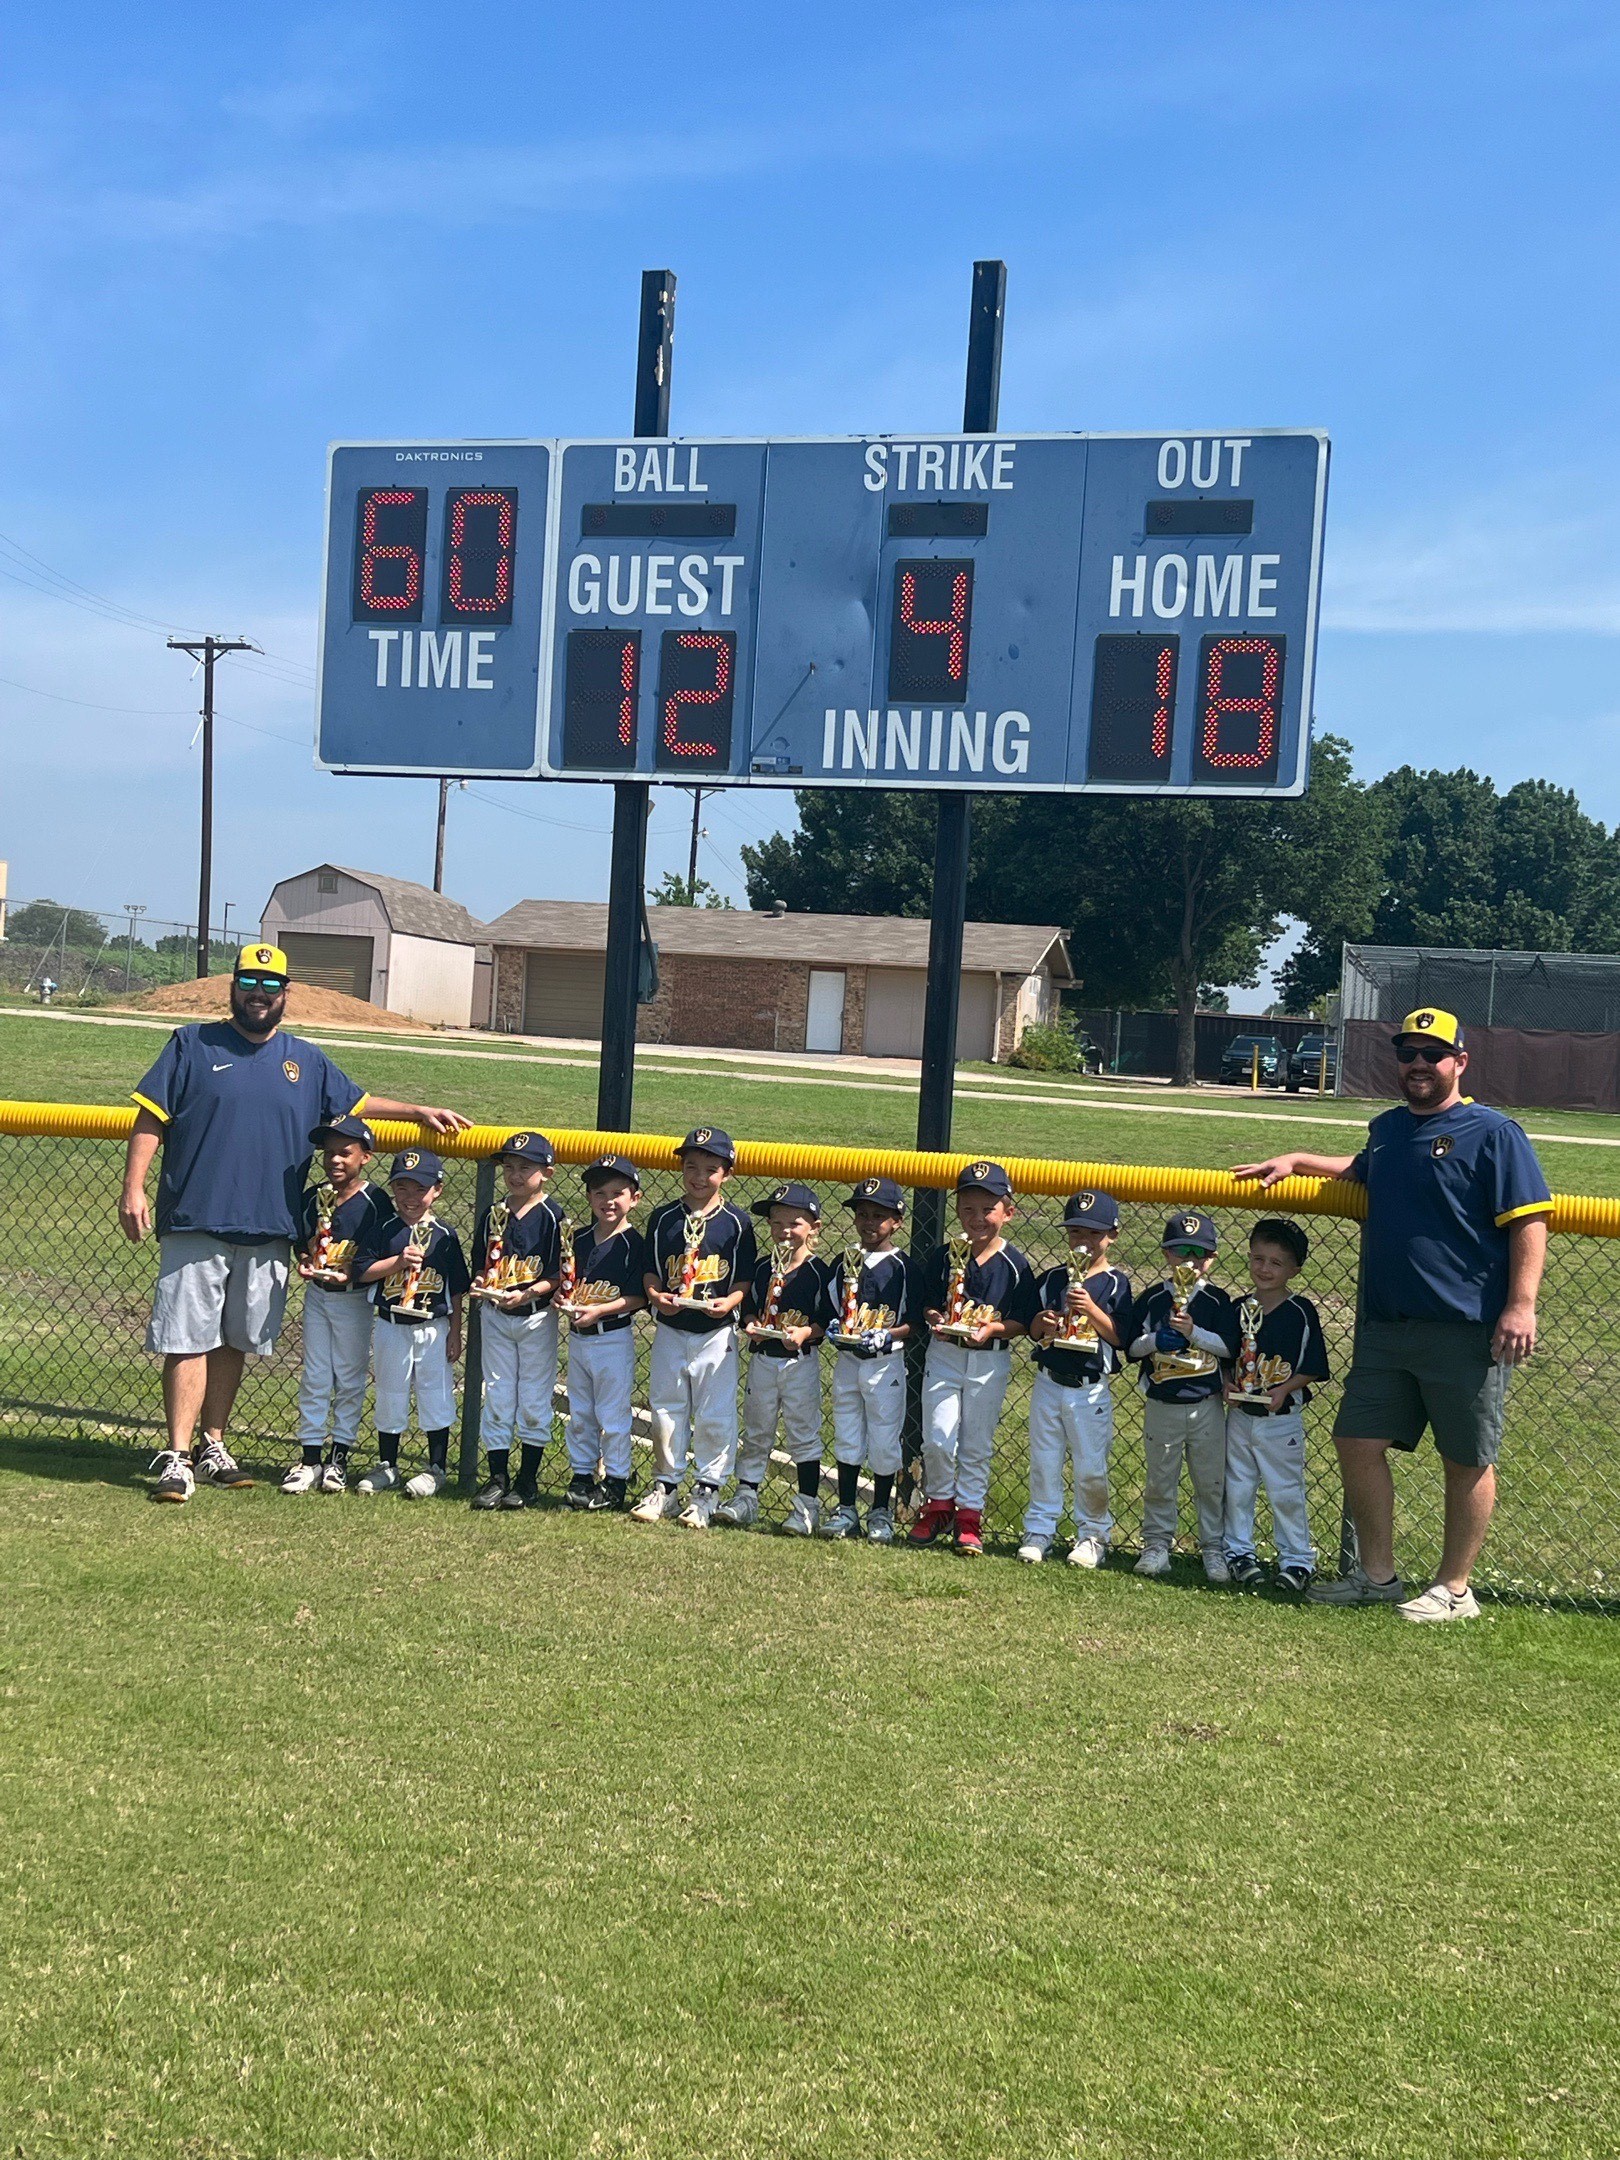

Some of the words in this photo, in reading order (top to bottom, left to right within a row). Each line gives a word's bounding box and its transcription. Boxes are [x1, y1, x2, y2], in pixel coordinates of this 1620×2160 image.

[395, 452, 483, 461] DAKTRONICS
[614, 447, 708, 493] BALL
[863, 443, 1016, 492] STRIKE
[1157, 439, 1251, 490] OUT
[361, 491, 511, 611] 60
[568, 553, 745, 616] GUEST
[1109, 553, 1281, 619] HOME
[900, 571, 967, 681] 4
[368, 629, 496, 690] TIME
[617, 634, 730, 756] 12
[1151, 639, 1279, 768] 18
[821, 708, 1031, 774] INNING
